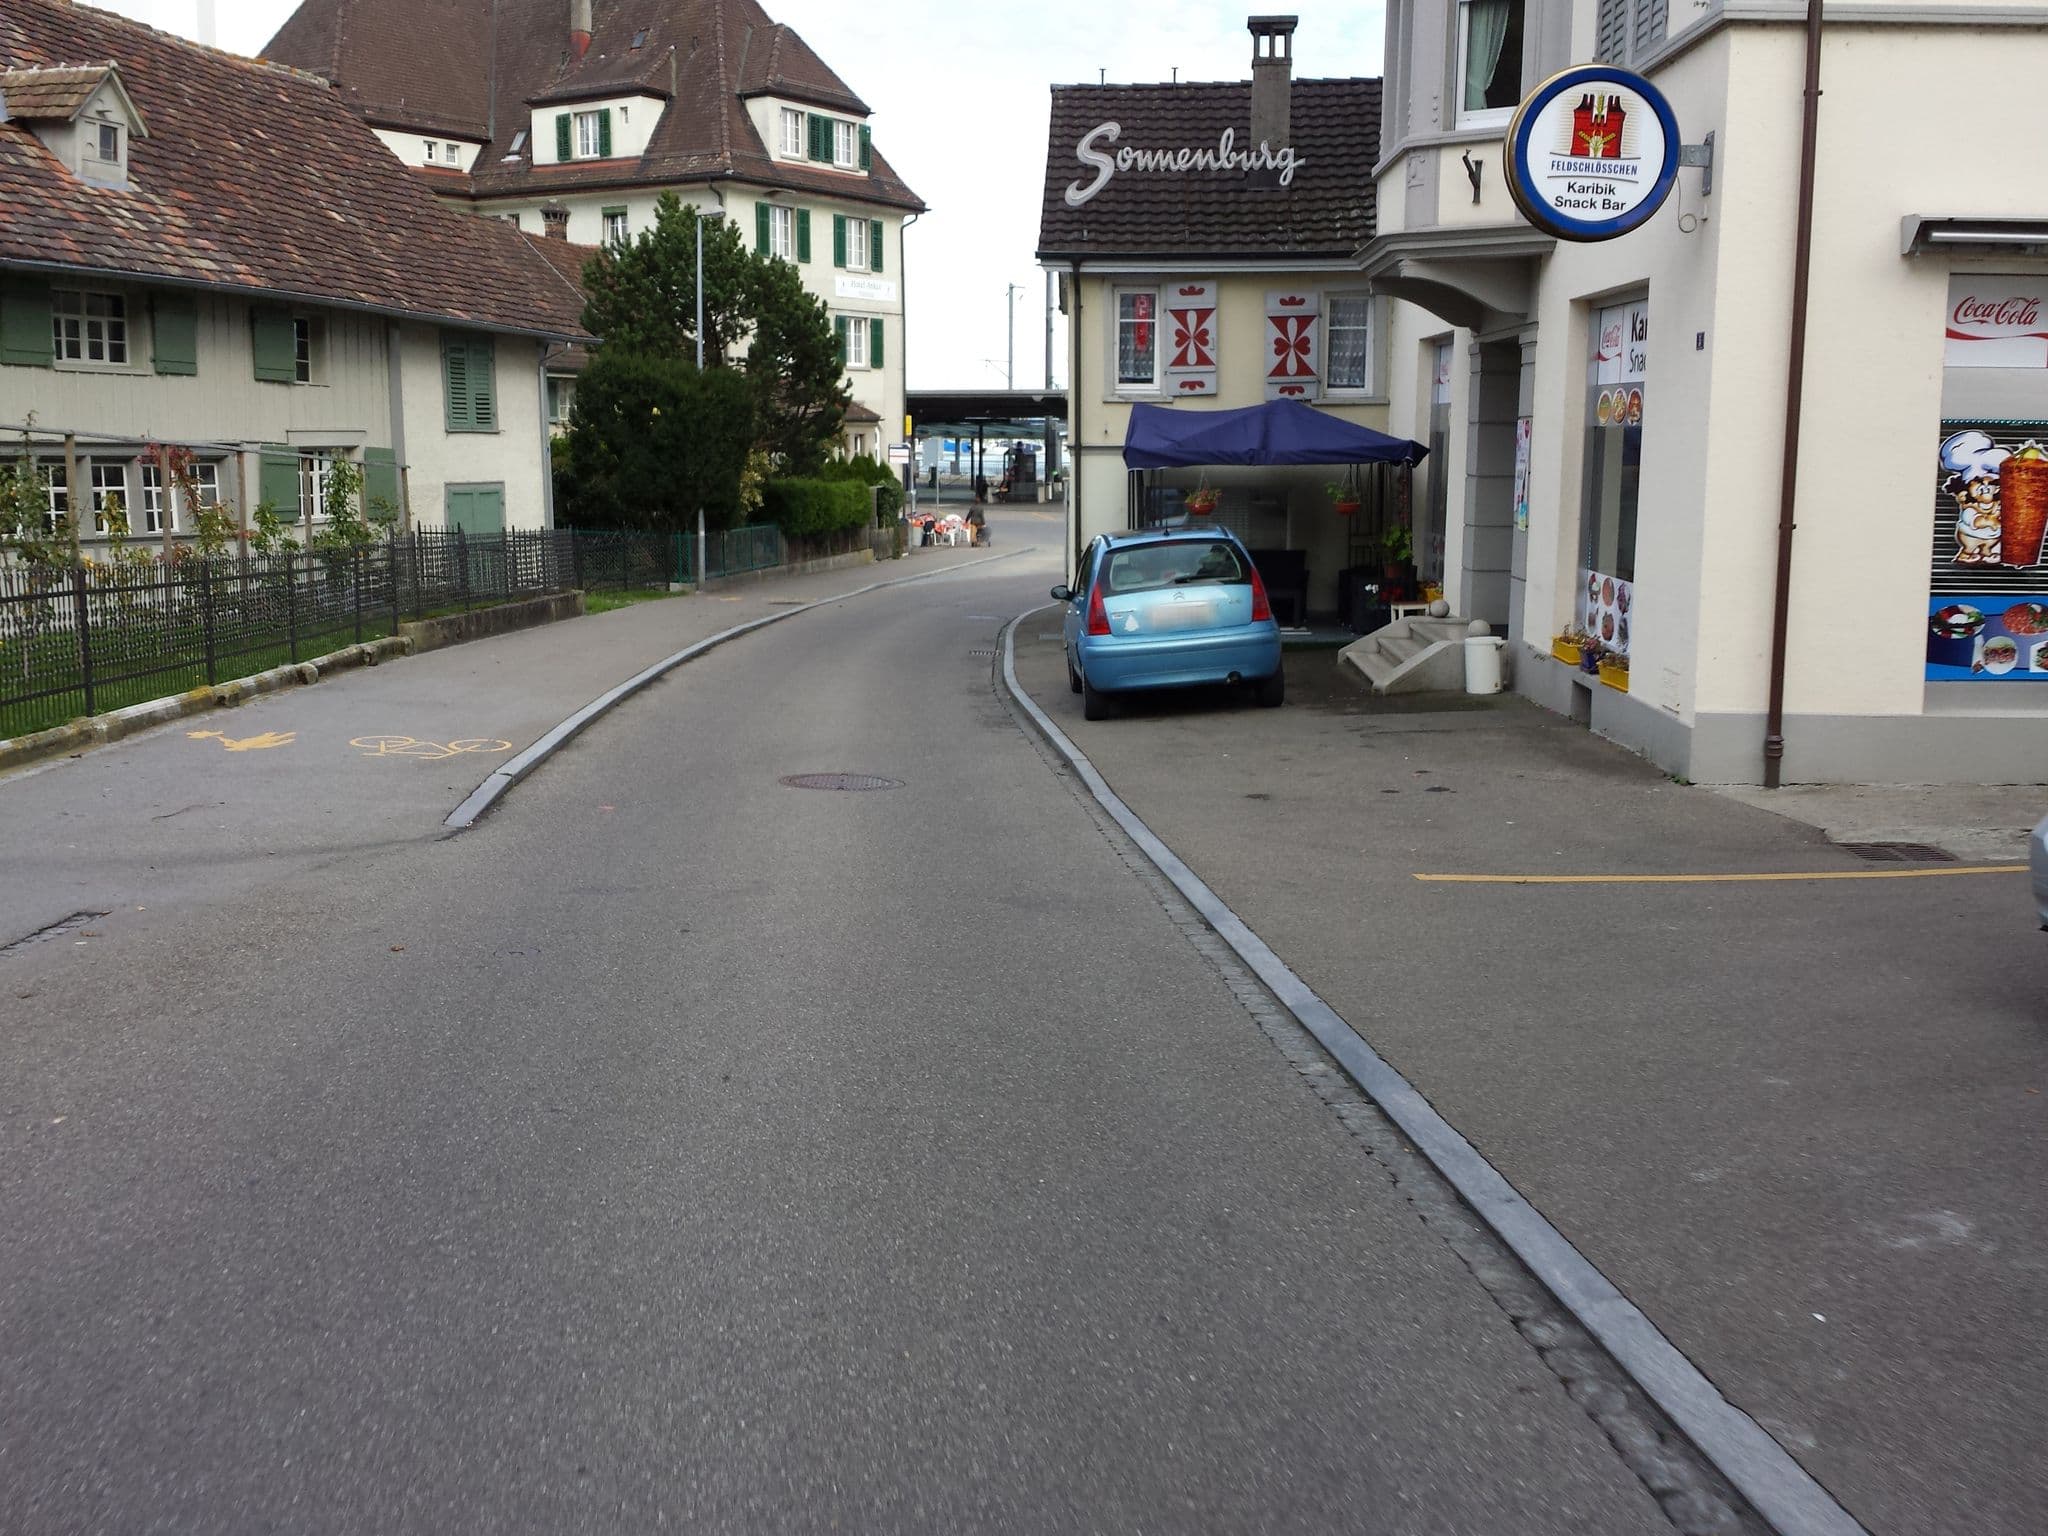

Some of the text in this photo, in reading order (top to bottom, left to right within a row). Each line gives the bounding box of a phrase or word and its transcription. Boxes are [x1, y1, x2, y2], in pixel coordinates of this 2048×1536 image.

[1064, 121, 1306, 207] Sonnenburg
[1551, 160, 1638, 176] FELDSCHLÖSSCHEN
[1567, 181, 1616, 196] Karibik
[1554, 196, 1626, 211] Snack Bar
[1953, 296, 2041, 325] Coca-Cola
